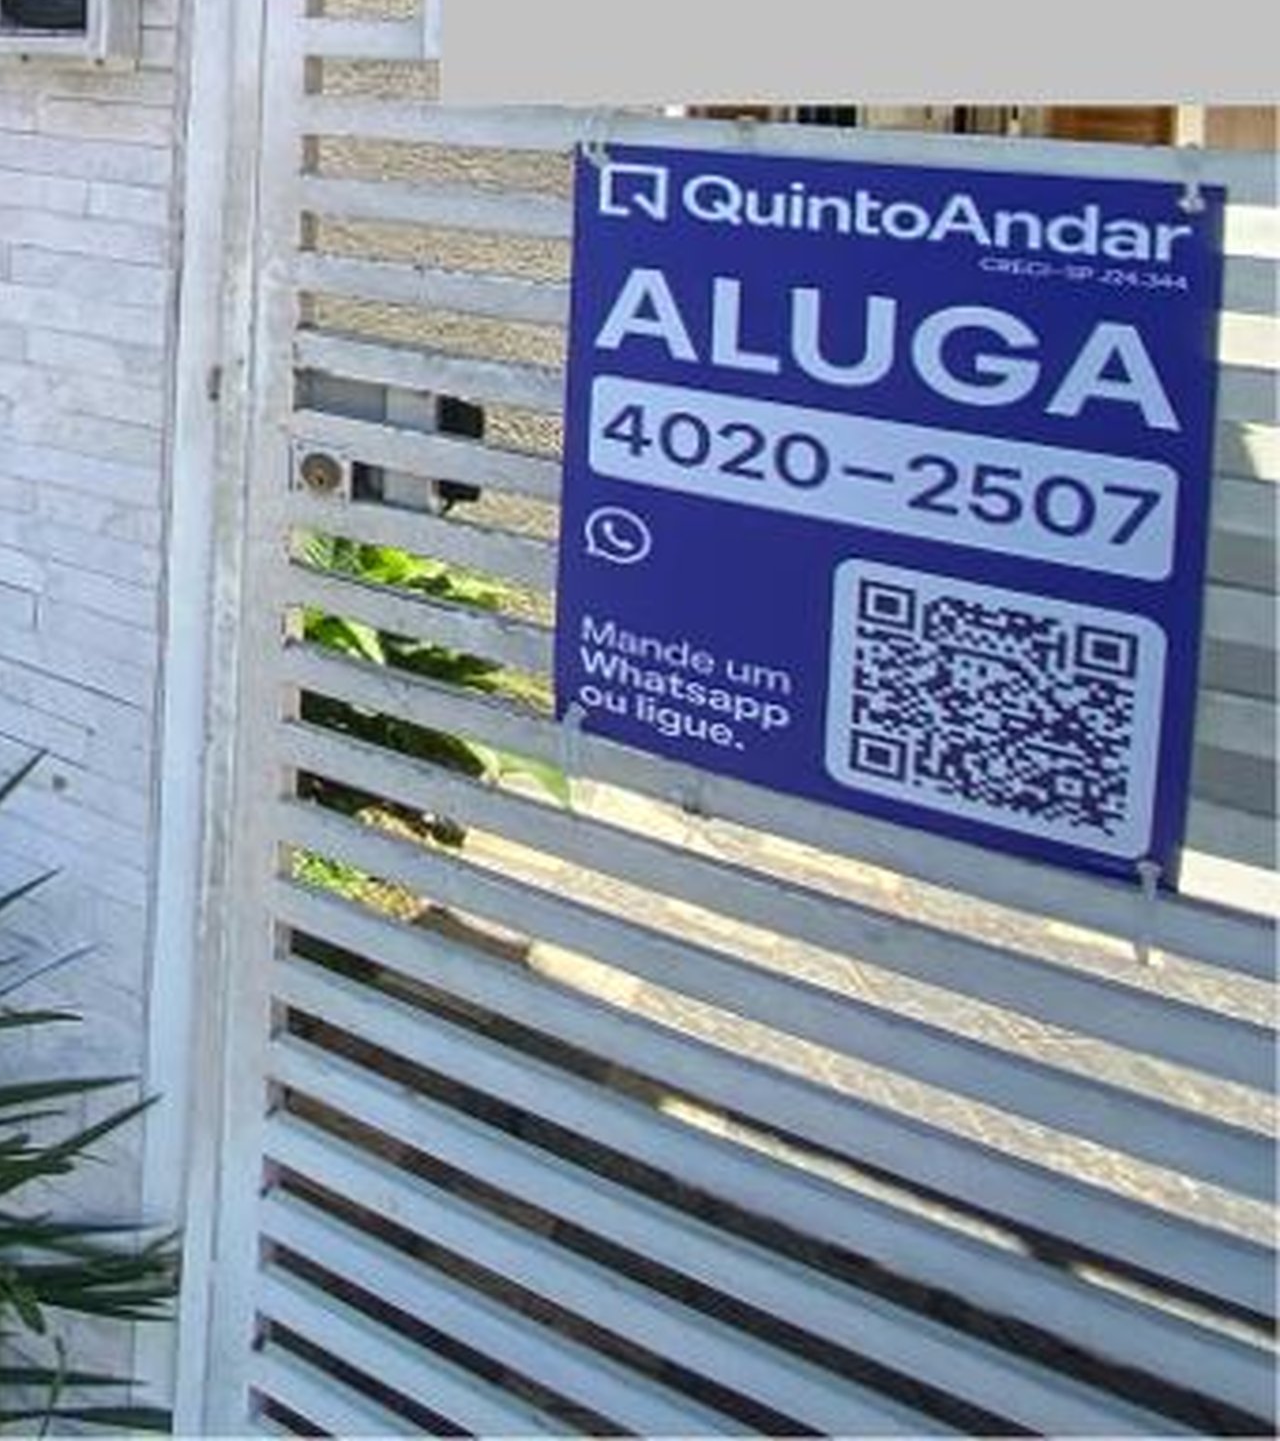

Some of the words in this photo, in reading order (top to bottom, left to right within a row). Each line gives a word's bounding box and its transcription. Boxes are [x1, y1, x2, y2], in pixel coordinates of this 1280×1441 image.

[682, 173, 1193, 263] QuintoAndar
[595, 267, 1183, 432] ALUGA
[601, 402, 1162, 546] 4020-2507
[580, 615, 717, 674] Mande
[724, 658, 792, 695] um
[580, 646, 792, 730] Whatsapp
[579, 681, 627, 714] ou
[633, 689, 747, 753] ligue.
